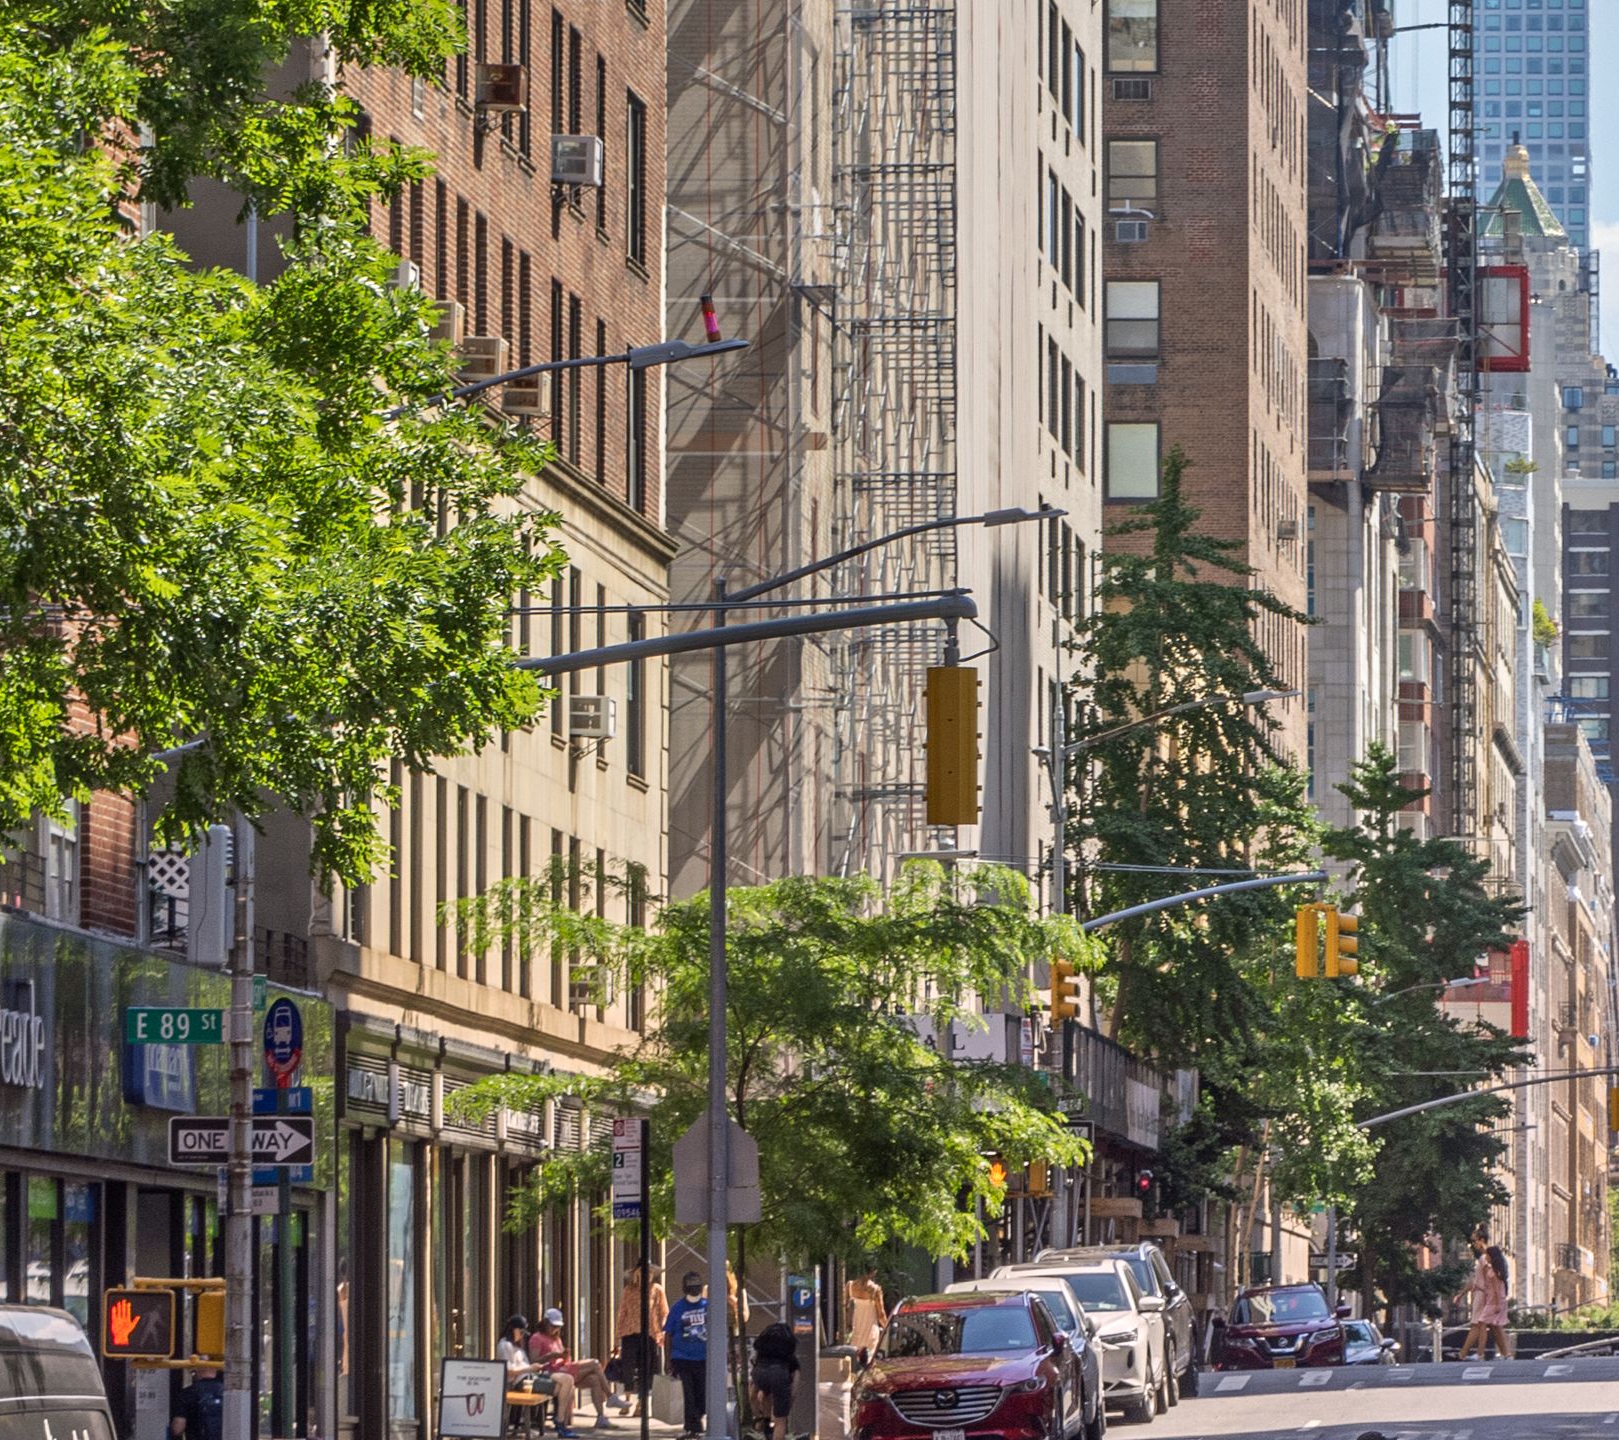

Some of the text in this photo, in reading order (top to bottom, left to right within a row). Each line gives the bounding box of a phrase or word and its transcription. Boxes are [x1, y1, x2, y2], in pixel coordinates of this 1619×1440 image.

[136, 1012, 216, 1040] E 89 St
[183, 1132, 294, 1150] ONE WAY
[615, 1154, 622, 1167] 2
[799, 1289, 810, 1306] P
